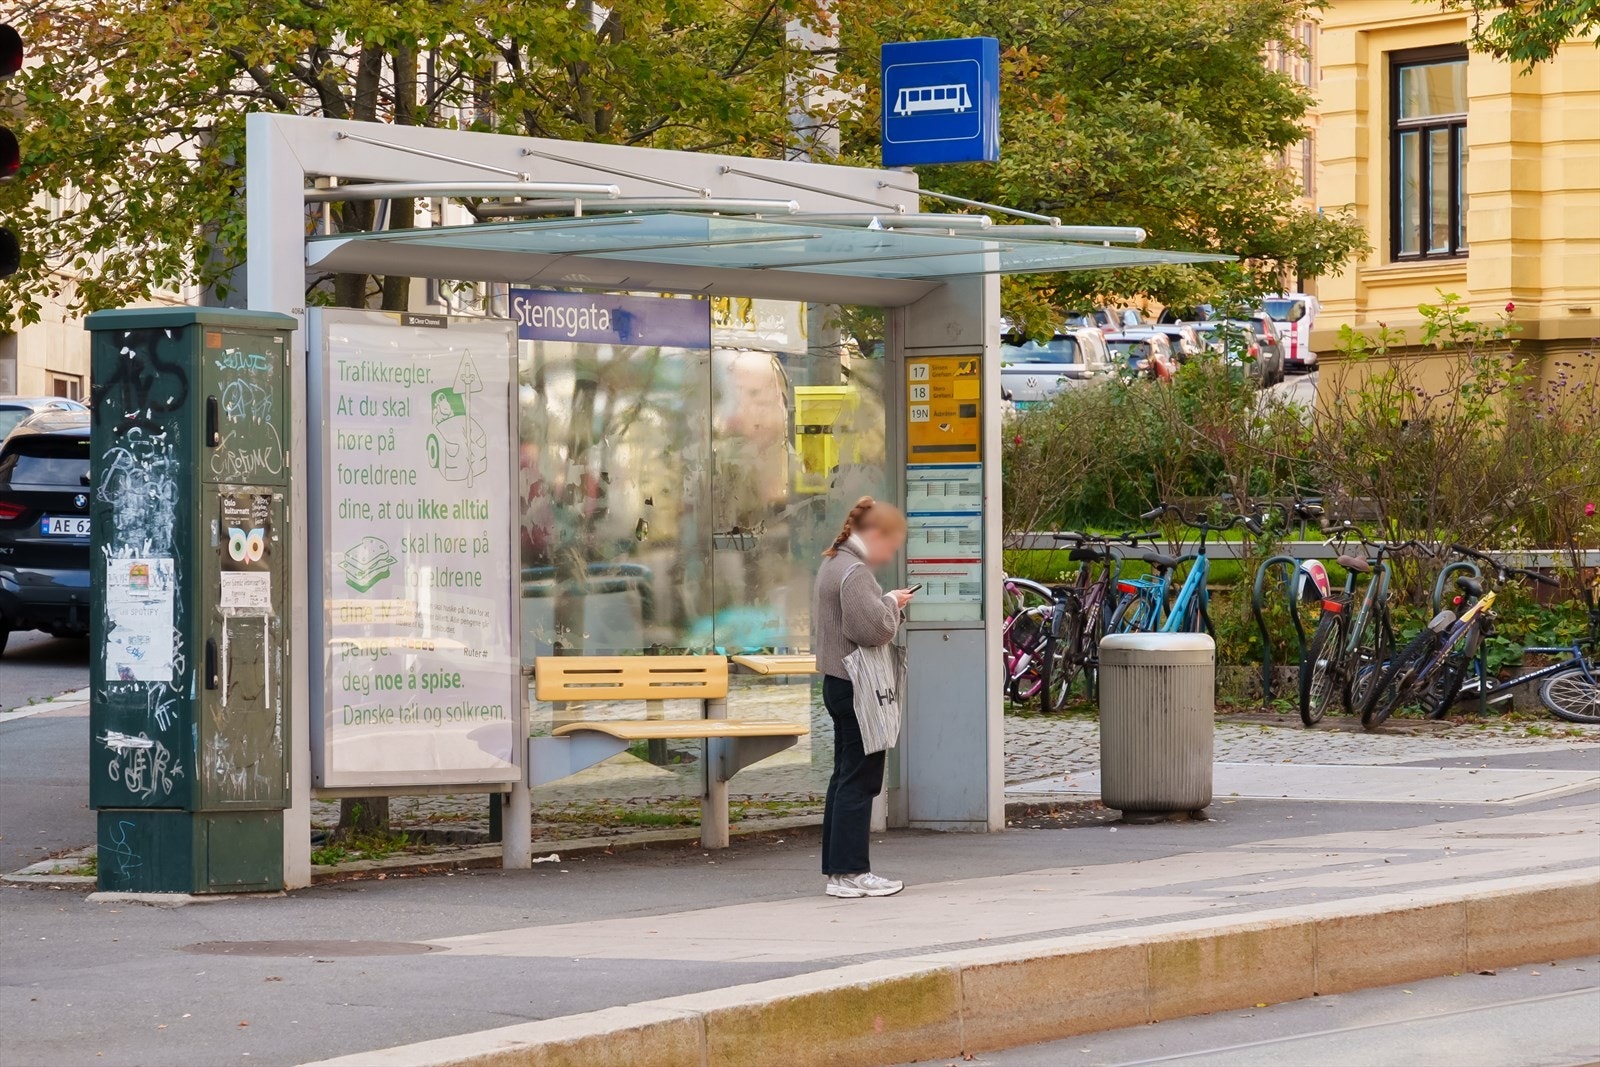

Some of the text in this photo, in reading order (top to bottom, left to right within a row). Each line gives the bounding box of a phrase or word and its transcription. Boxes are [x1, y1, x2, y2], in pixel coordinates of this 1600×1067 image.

[513, 296, 610, 337] Stensgata
[338, 360, 434, 388] Trafikkregler.
[914, 367, 926, 378] 17
[913, 387, 926, 398] 18
[337, 395, 410, 417] At du skal
[911, 409, 928, 419] 19N
[337, 427, 396, 455] høre på
[337, 463, 417, 486] foreldrene
[338, 499, 489, 521] dine, at du ikke alltid
[53, 519, 71, 533] AE
[401, 531, 490, 557] skal høre på
[131, 608, 159, 616] SPOTIFY
[463, 647, 488, 658] Ruter#
[342, 666, 465, 695] deg noe å spise.
[343, 703, 394, 726] Danske
[424, 706, 442, 727] og
[446, 701, 506, 723] solkrem.
